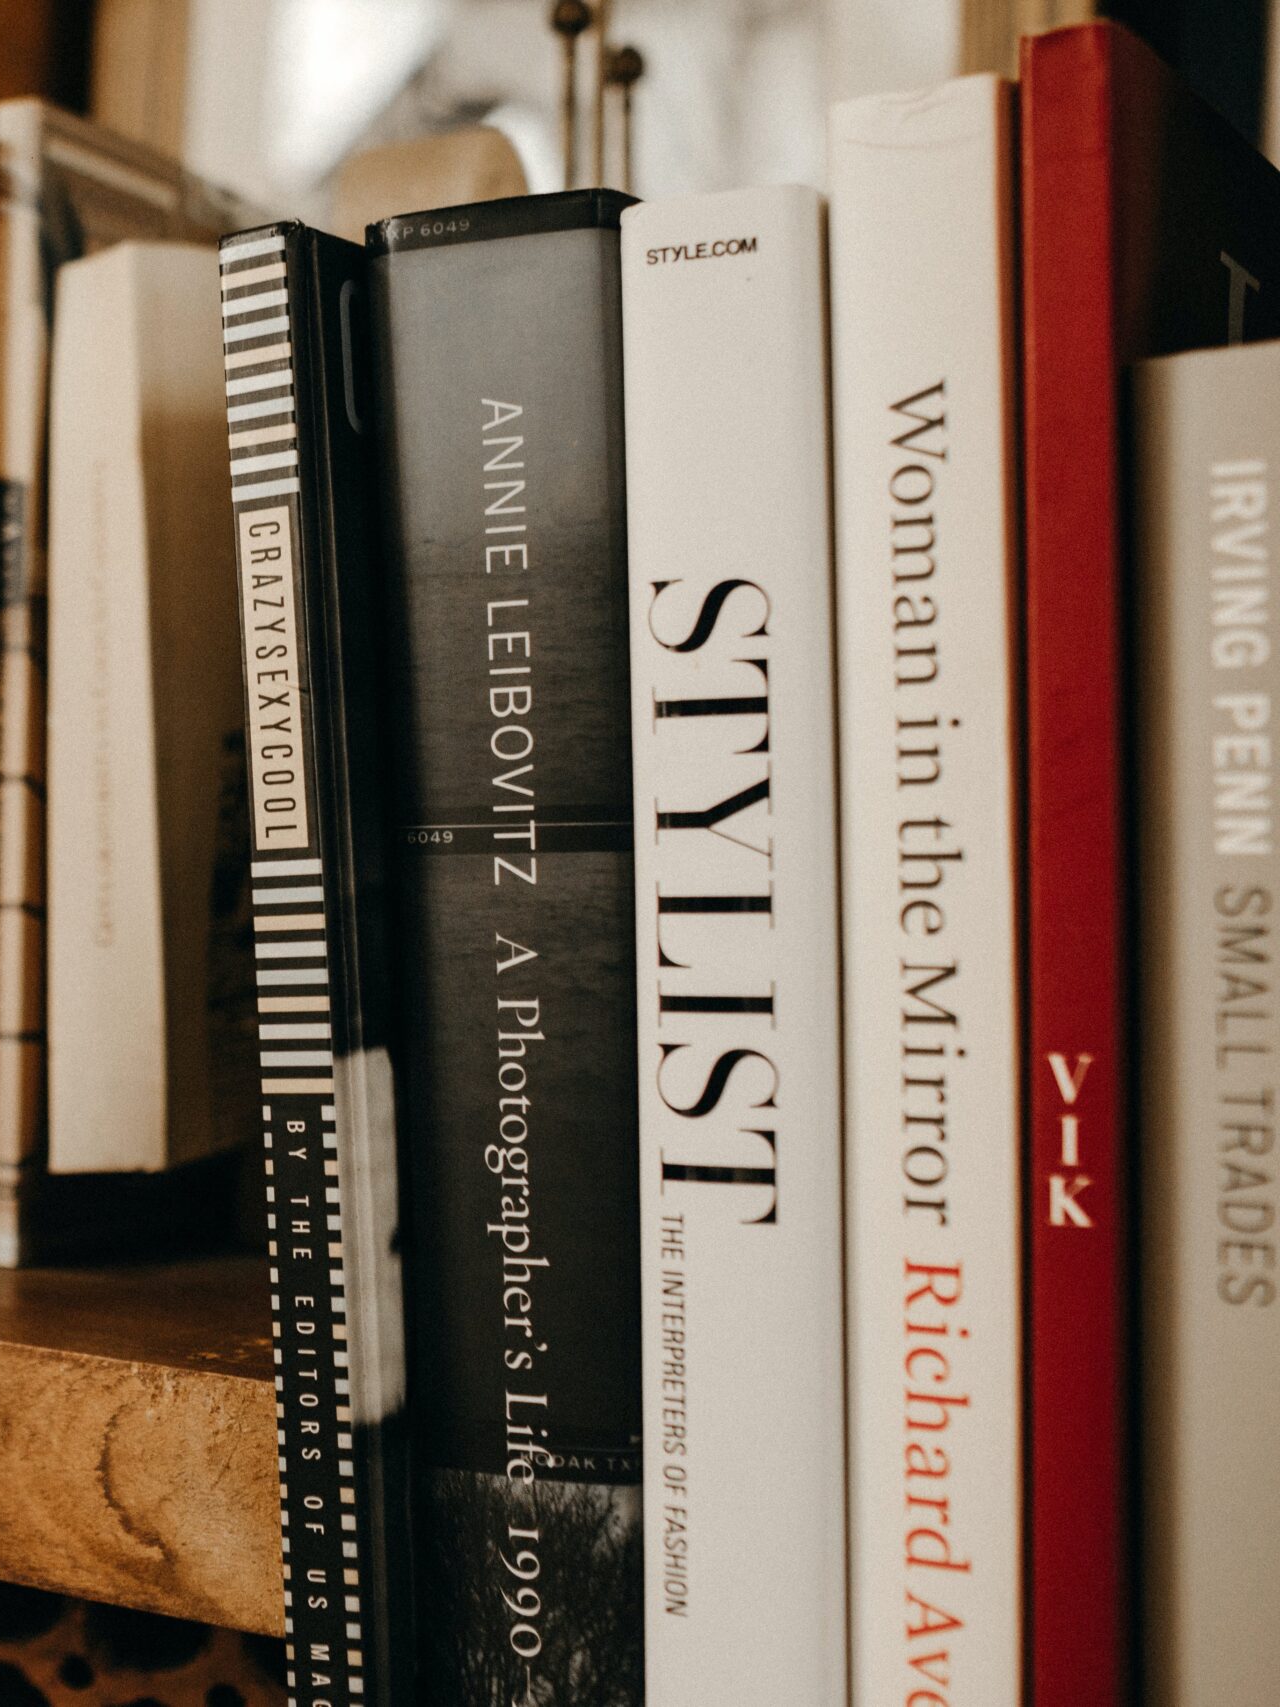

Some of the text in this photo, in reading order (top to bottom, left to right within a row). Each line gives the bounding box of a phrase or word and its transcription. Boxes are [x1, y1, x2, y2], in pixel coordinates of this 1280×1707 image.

[420, 218, 470, 237] 6049
[646, 237, 758, 266] STYLE.COM
[481, 397, 528, 573] ANNIE
[248, 519, 297, 840] CRAZYSEXYCOOL
[486, 599, 538, 886] LEIBOVITZ
[888, 380, 967, 1227] Woman in the Mirror
[1211, 458, 1276, 1308] IRVING PENN SMALL TRADES
[494, 930, 540, 976] A
[648, 577, 778, 1225] STYLIST
[285, 1118, 308, 1162] BY
[289, 1194, 313, 1260] THE
[1047, 1052, 1093, 1228] VIK
[294, 1295, 322, 1462] EDITORS
[504, 1388, 549, 1486] Life
[660, 1212, 690, 1618] THE INTERPRETERS OF FASHION
[902, 1258, 972, 1576] Richard
[303, 1494, 325, 1536] OF
[306, 1568, 328, 1611] US
[497, 1525, 543, 1707] 1990–
